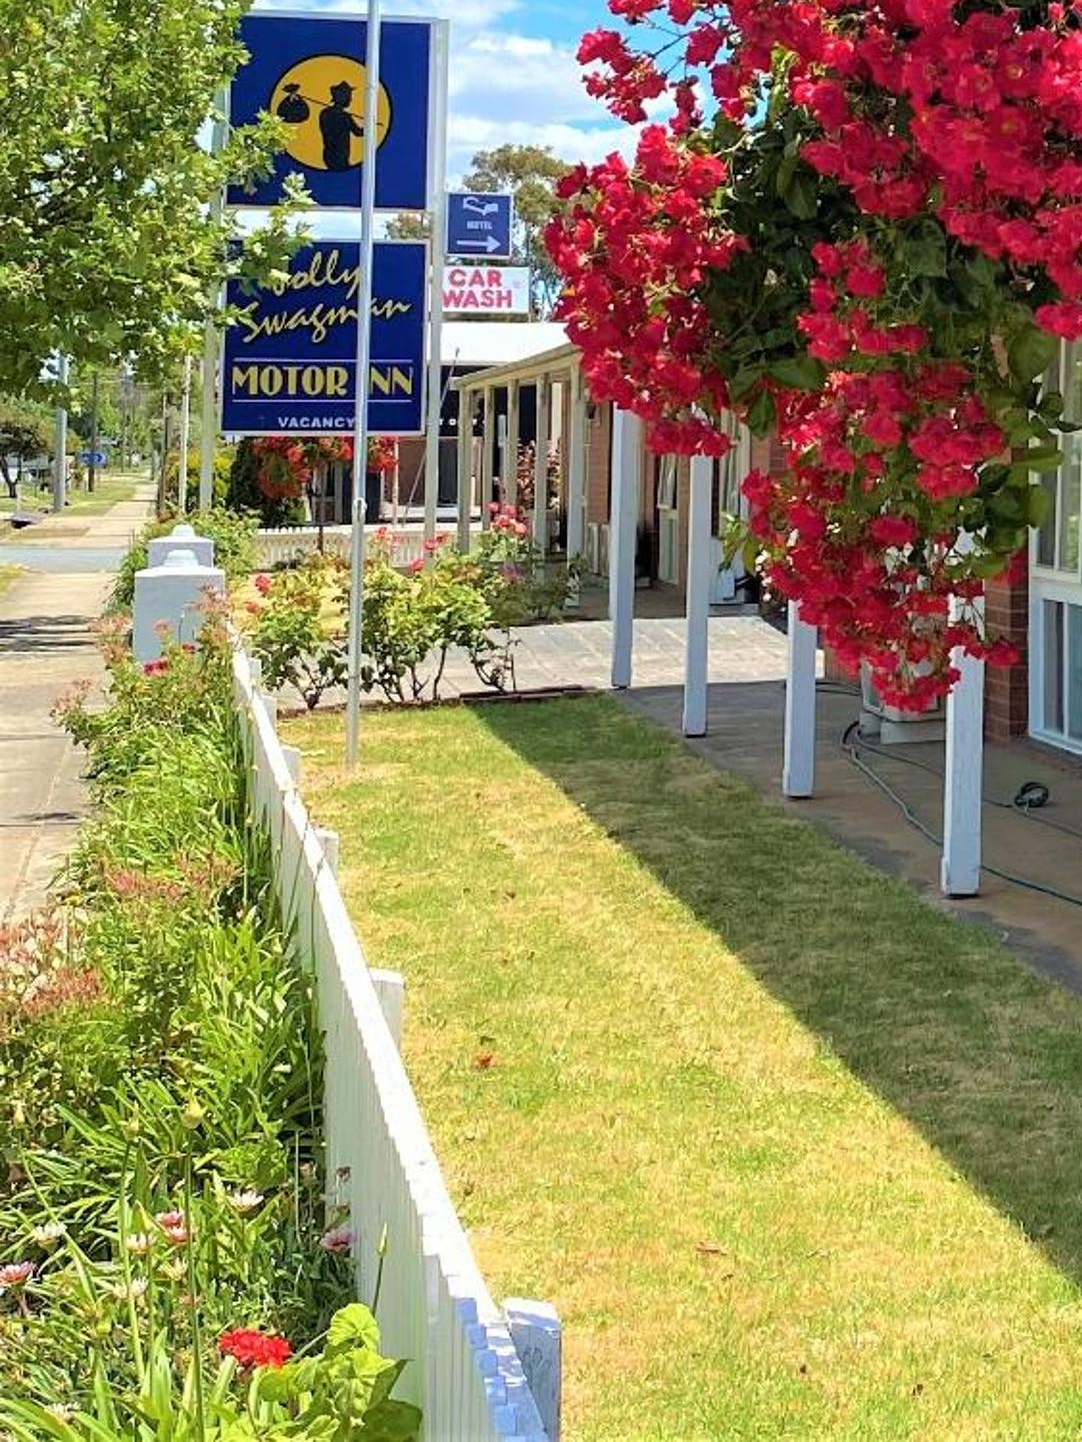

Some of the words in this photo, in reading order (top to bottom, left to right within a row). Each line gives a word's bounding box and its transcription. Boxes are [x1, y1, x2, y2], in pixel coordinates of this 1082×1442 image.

[448, 269, 503, 287] CAR
[442, 289, 513, 308] WASH
[232, 366, 349, 396] MOTOR
[369, 366, 414, 396] NN
[278, 416, 357, 428] VACANCY
